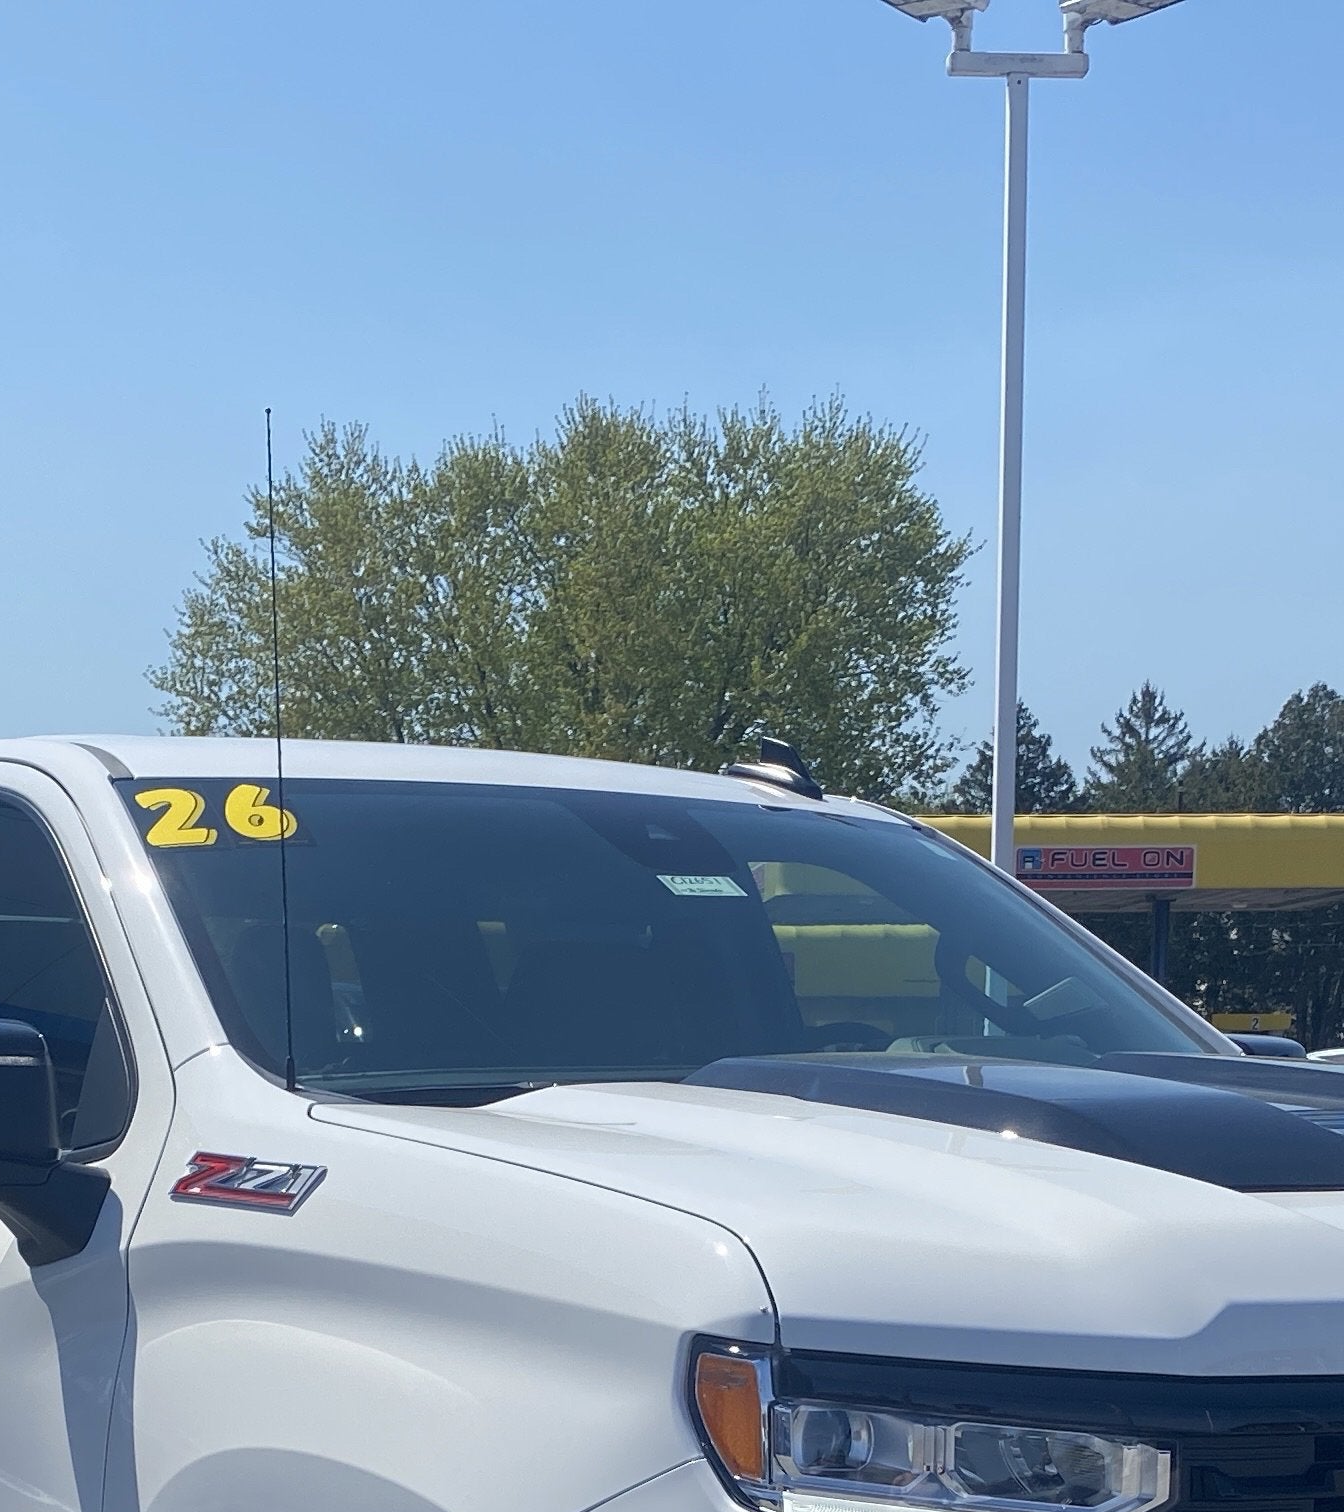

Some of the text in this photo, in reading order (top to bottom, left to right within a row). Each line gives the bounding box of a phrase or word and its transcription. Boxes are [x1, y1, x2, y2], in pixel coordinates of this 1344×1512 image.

[134, 784, 298, 848] 26
[1050, 850, 1185, 868] FUEL ON
[1252, 1018, 1259, 1030] 2
[168, 1151, 329, 1217] Z71
